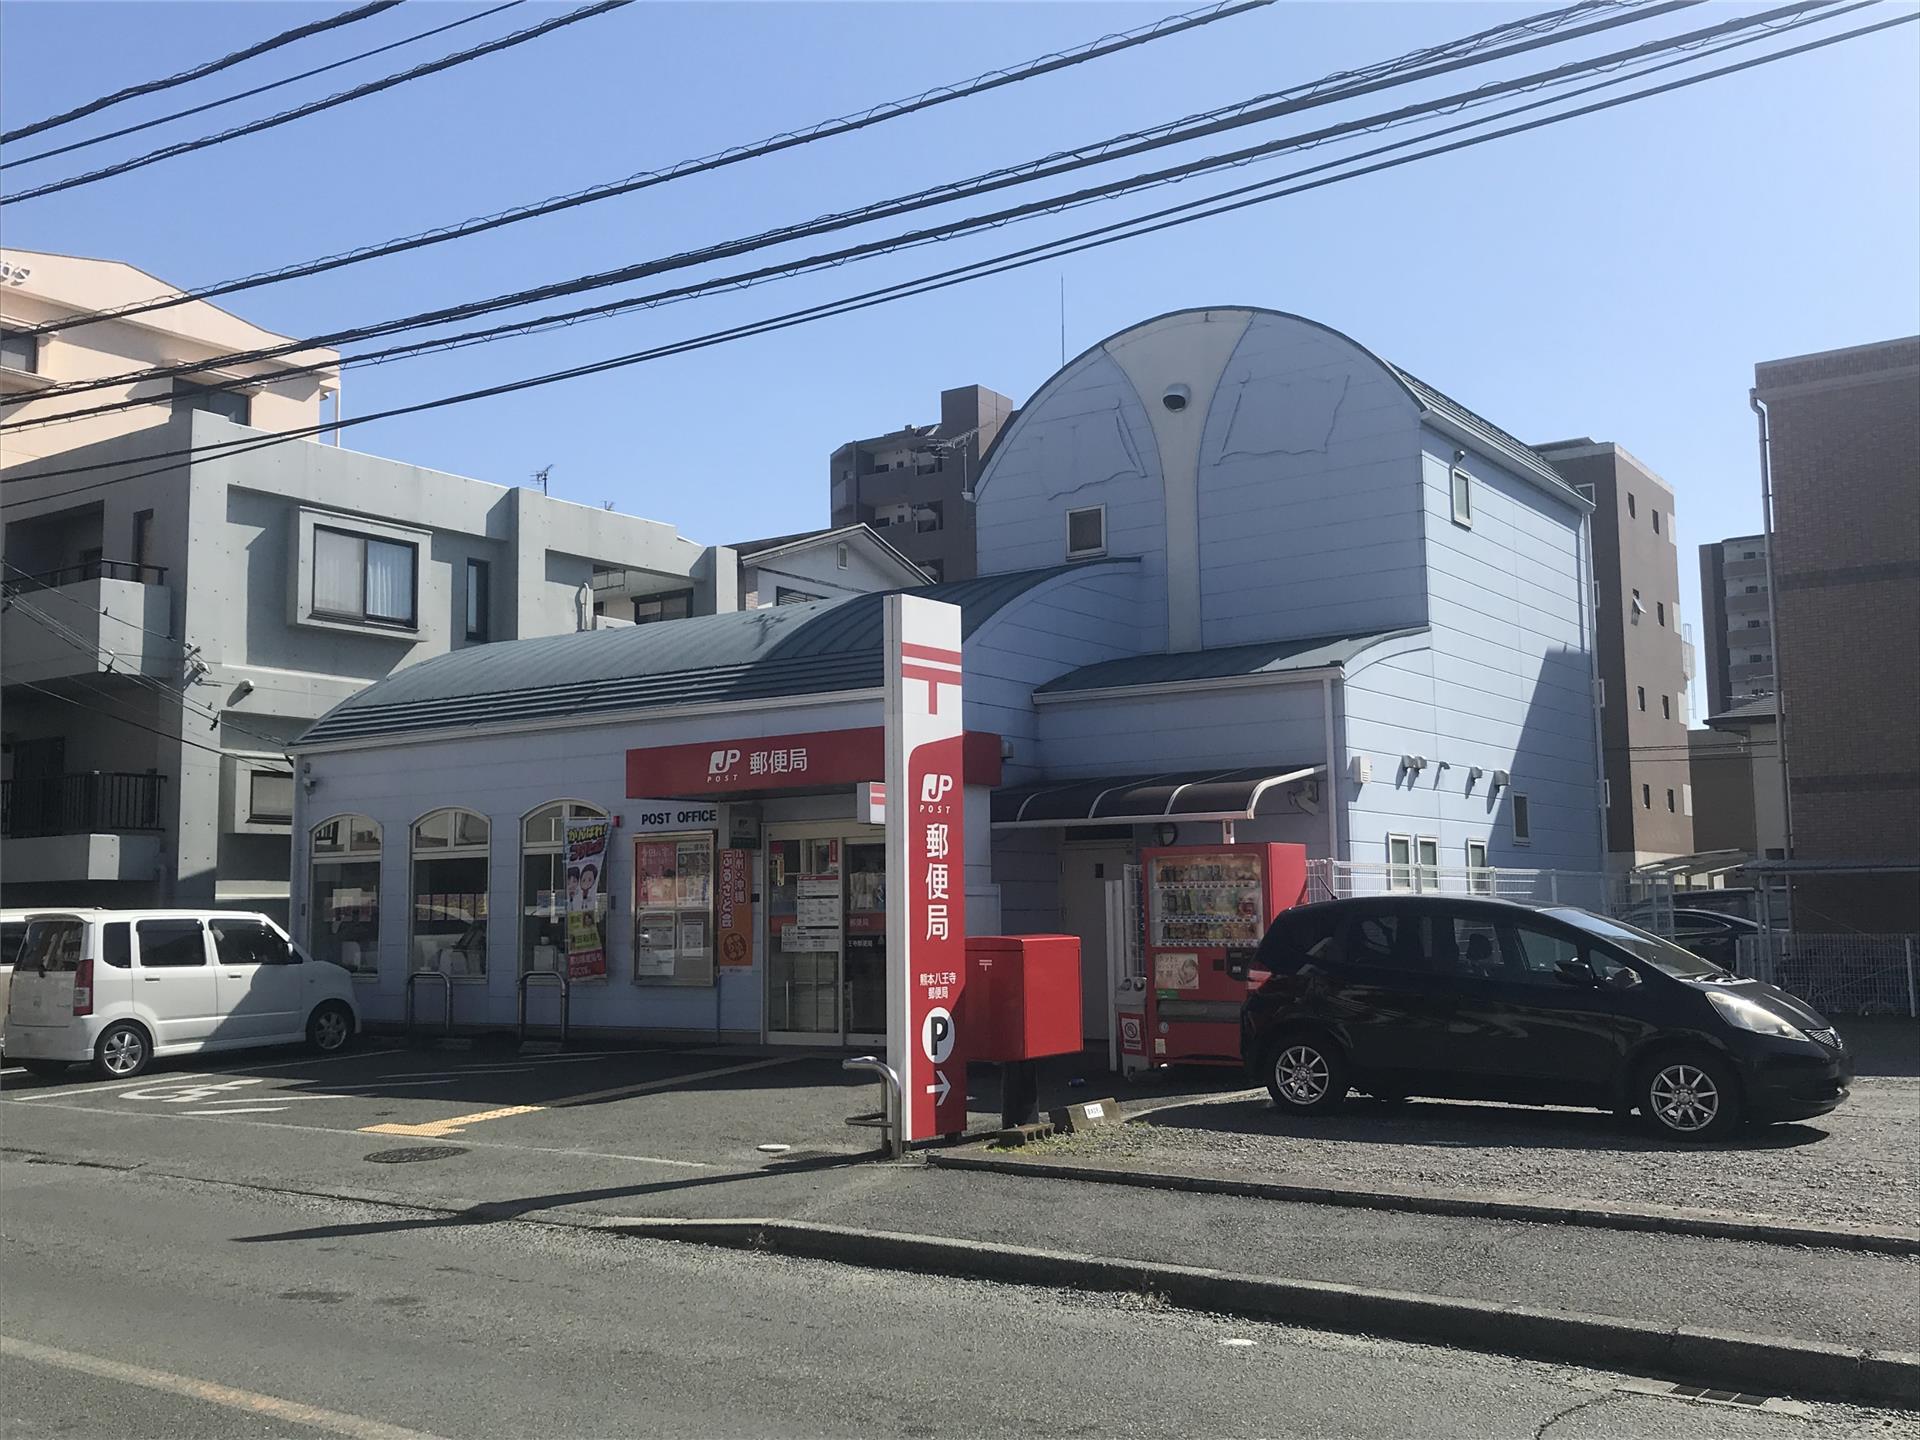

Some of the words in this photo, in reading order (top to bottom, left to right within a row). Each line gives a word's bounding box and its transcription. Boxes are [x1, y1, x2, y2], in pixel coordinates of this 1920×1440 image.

[709, 749, 741, 774] JP
[749, 748, 808, 775] 郵便局
[707, 774, 738, 783] POST
[920, 773, 953, 802] JP
[641, 812, 672, 825] POST
[677, 809, 717, 823] OFFICE
[919, 805, 951, 814] POST
[925, 823, 950, 941] 郵便局
[919, 972, 957, 986] 熊本八王寺
[928, 986, 949, 999] 郵便局
[931, 1016, 949, 1056] P
